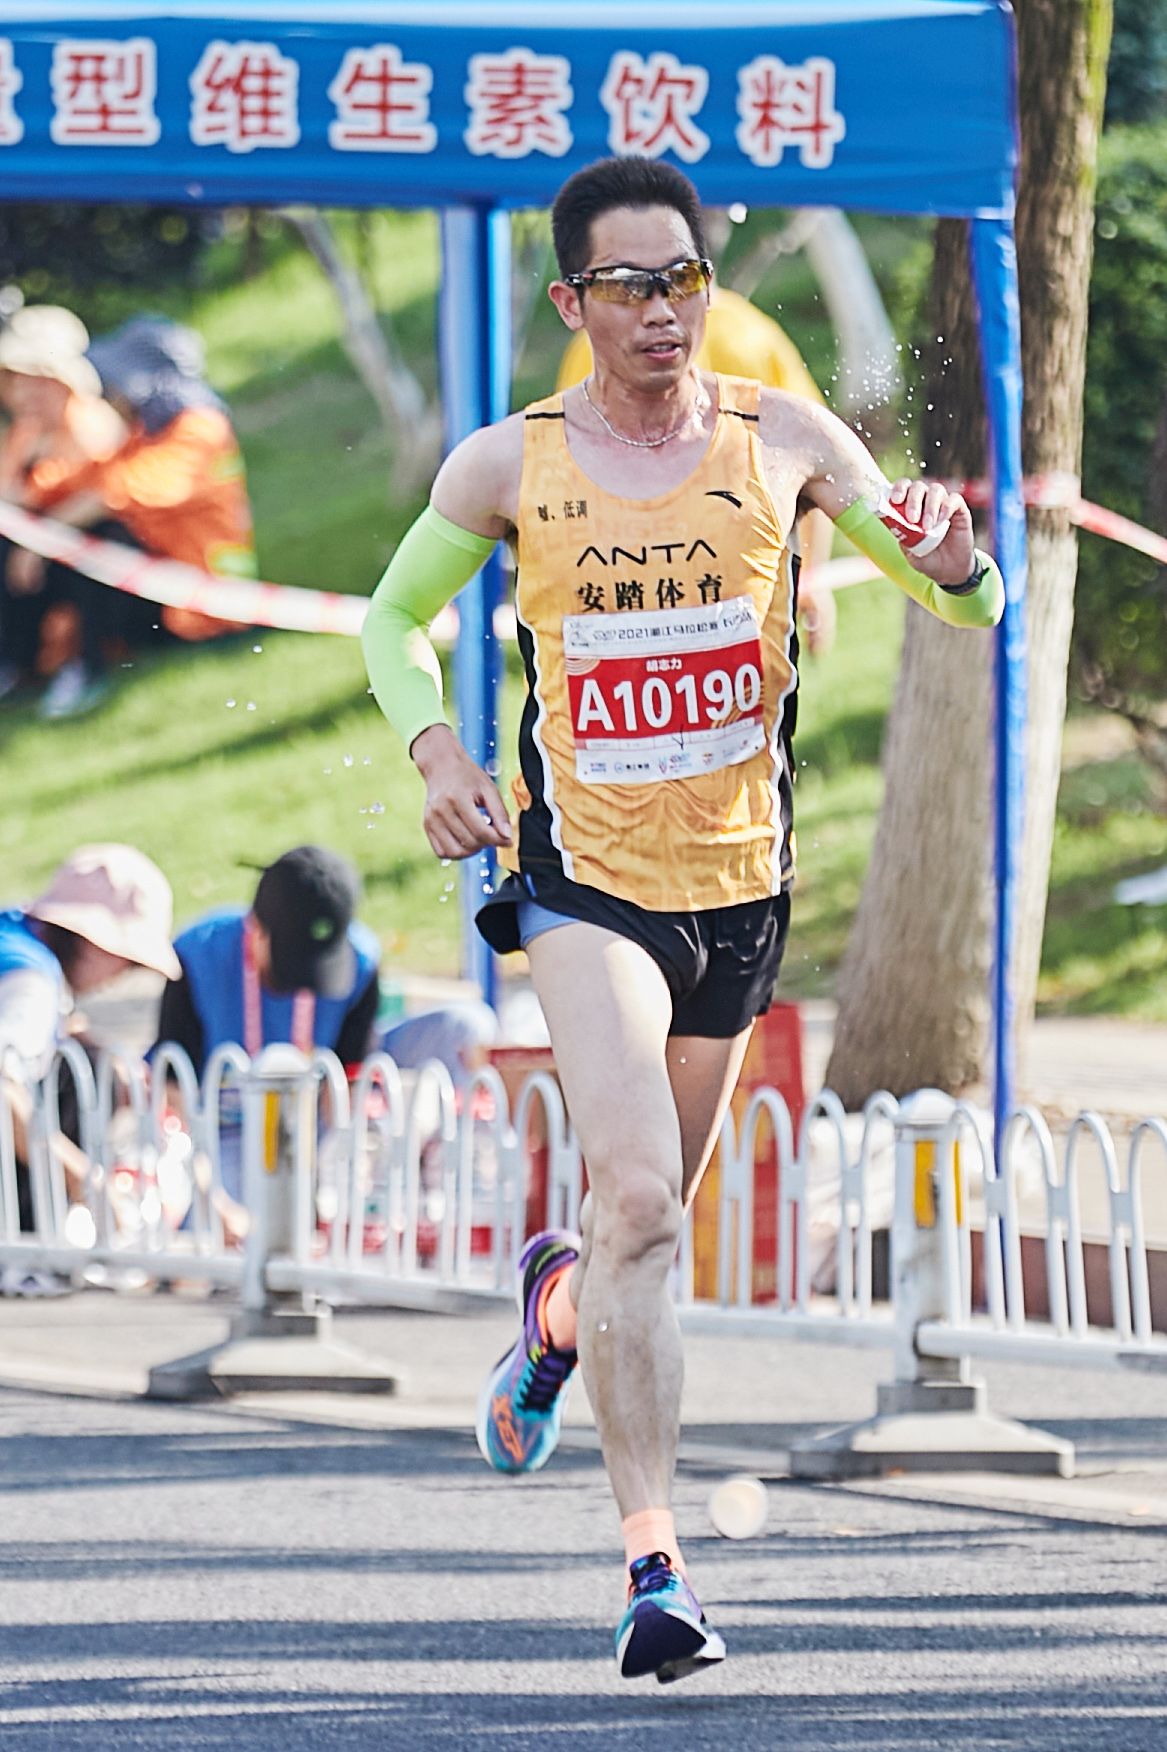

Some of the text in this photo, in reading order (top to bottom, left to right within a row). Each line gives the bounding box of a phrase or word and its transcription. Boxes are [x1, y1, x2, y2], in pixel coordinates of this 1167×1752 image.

[0, 38, 845, 168] 型维生素饮料
[576, 539, 717, 567] ANTA
[575, 573, 722, 613] 安踏体育
[576, 663, 761, 732] A10190
